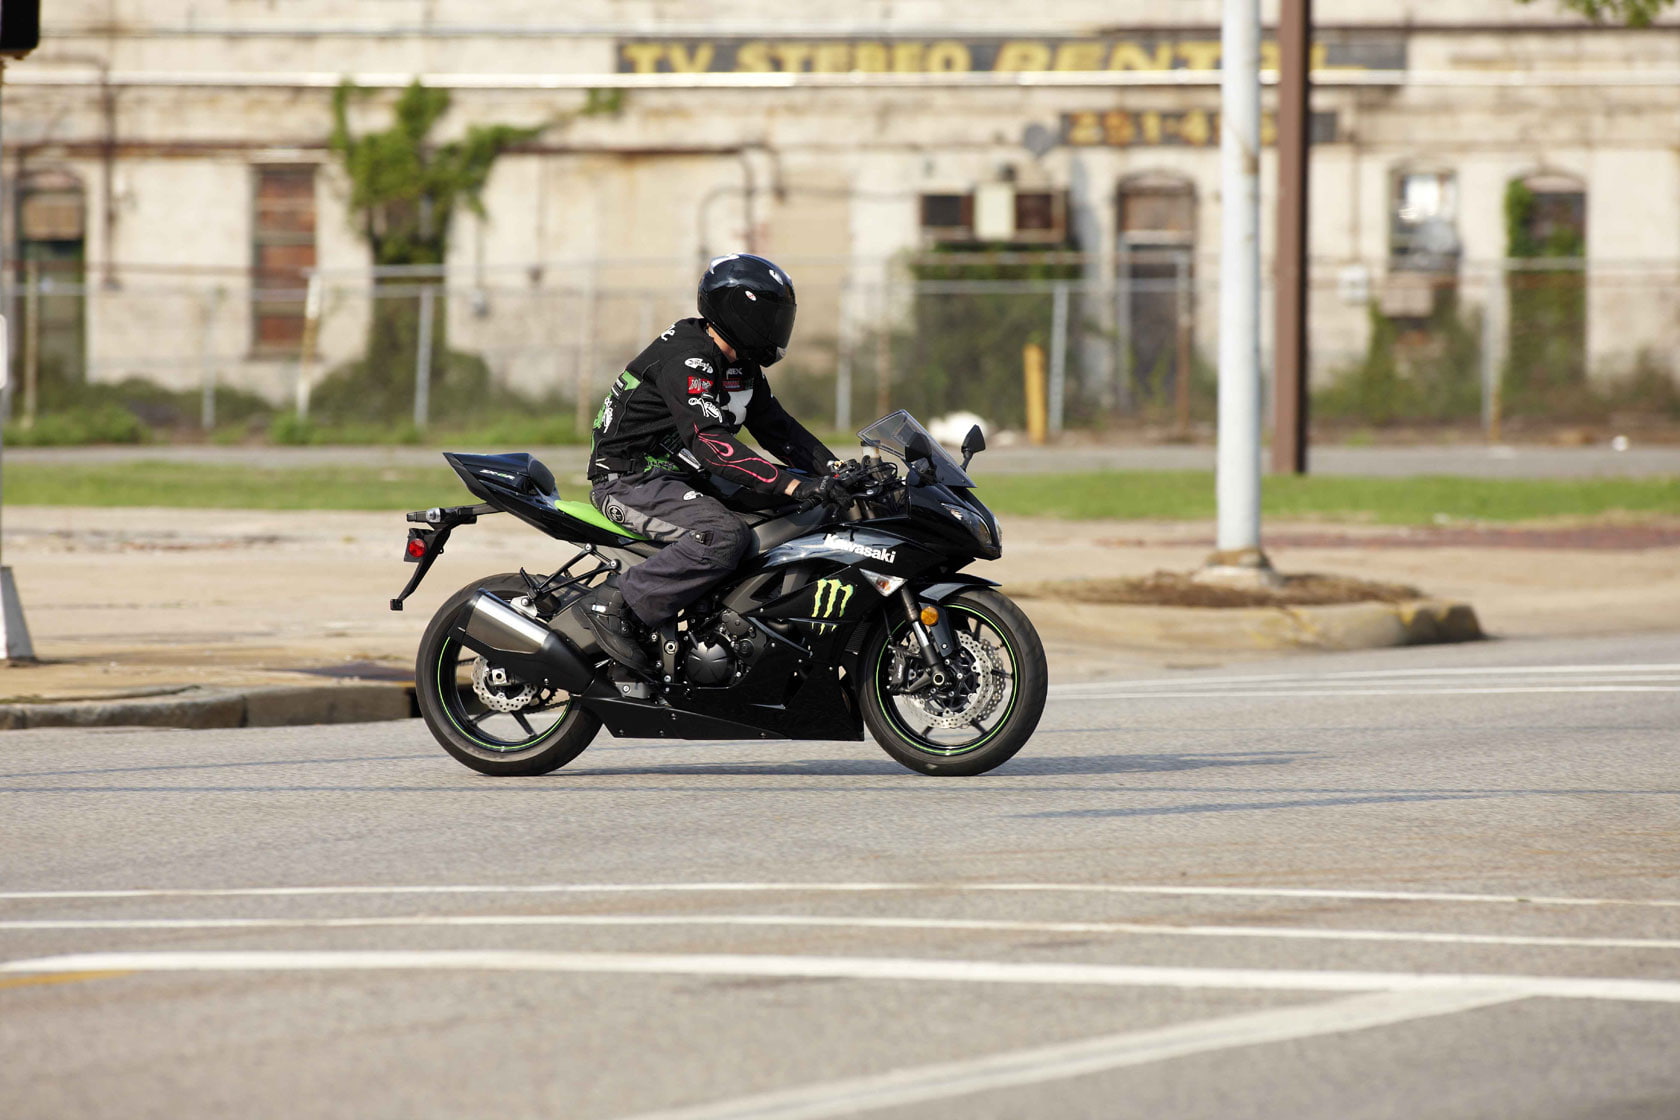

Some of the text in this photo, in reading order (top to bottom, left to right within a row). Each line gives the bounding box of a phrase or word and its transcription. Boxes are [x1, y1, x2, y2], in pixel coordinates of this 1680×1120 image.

[622, 42, 714, 75] TV
[736, 42, 973, 75] STEREO
[823, 533, 897, 564] Kawasaki
